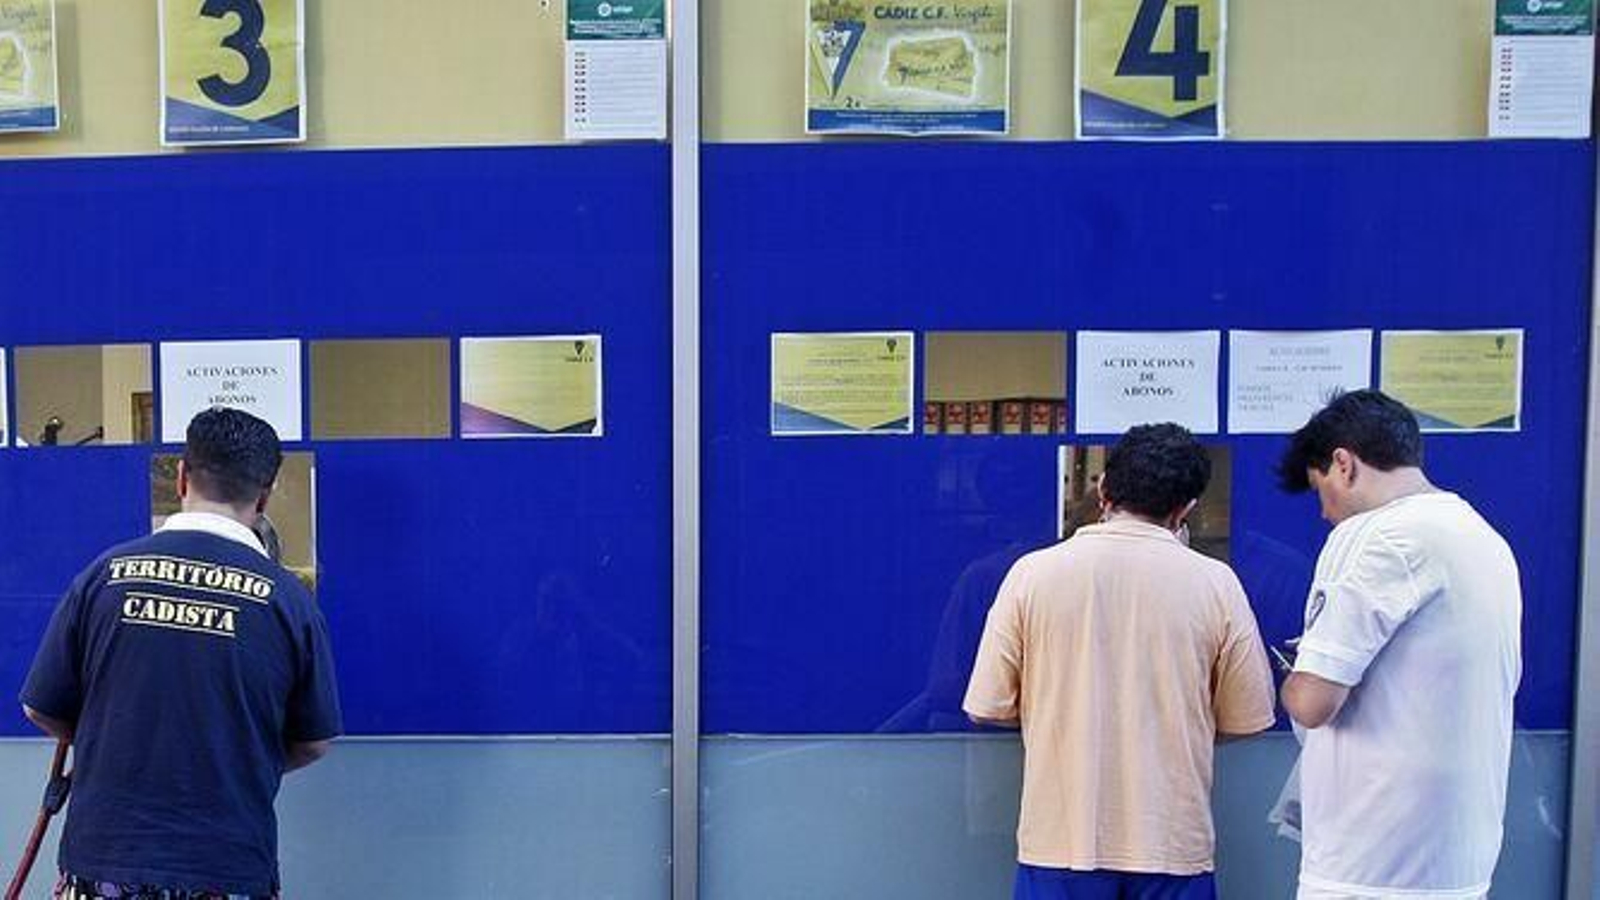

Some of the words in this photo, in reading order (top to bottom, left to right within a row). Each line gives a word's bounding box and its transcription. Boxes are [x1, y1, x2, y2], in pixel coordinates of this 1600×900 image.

[197, 0, 271, 106] 3
[1114, 0, 1209, 101] 4
[1102, 358, 1195, 368] ACTIVACIONES
[186, 366, 279, 377] ACTIVACIONES
[1139, 373, 1155, 381] DE
[222, 381, 240, 391] DE
[1121, 386, 1174, 396] ABONOS
[208, 395, 257, 403] ABONOS
[122, 598, 235, 631] CADISTA
